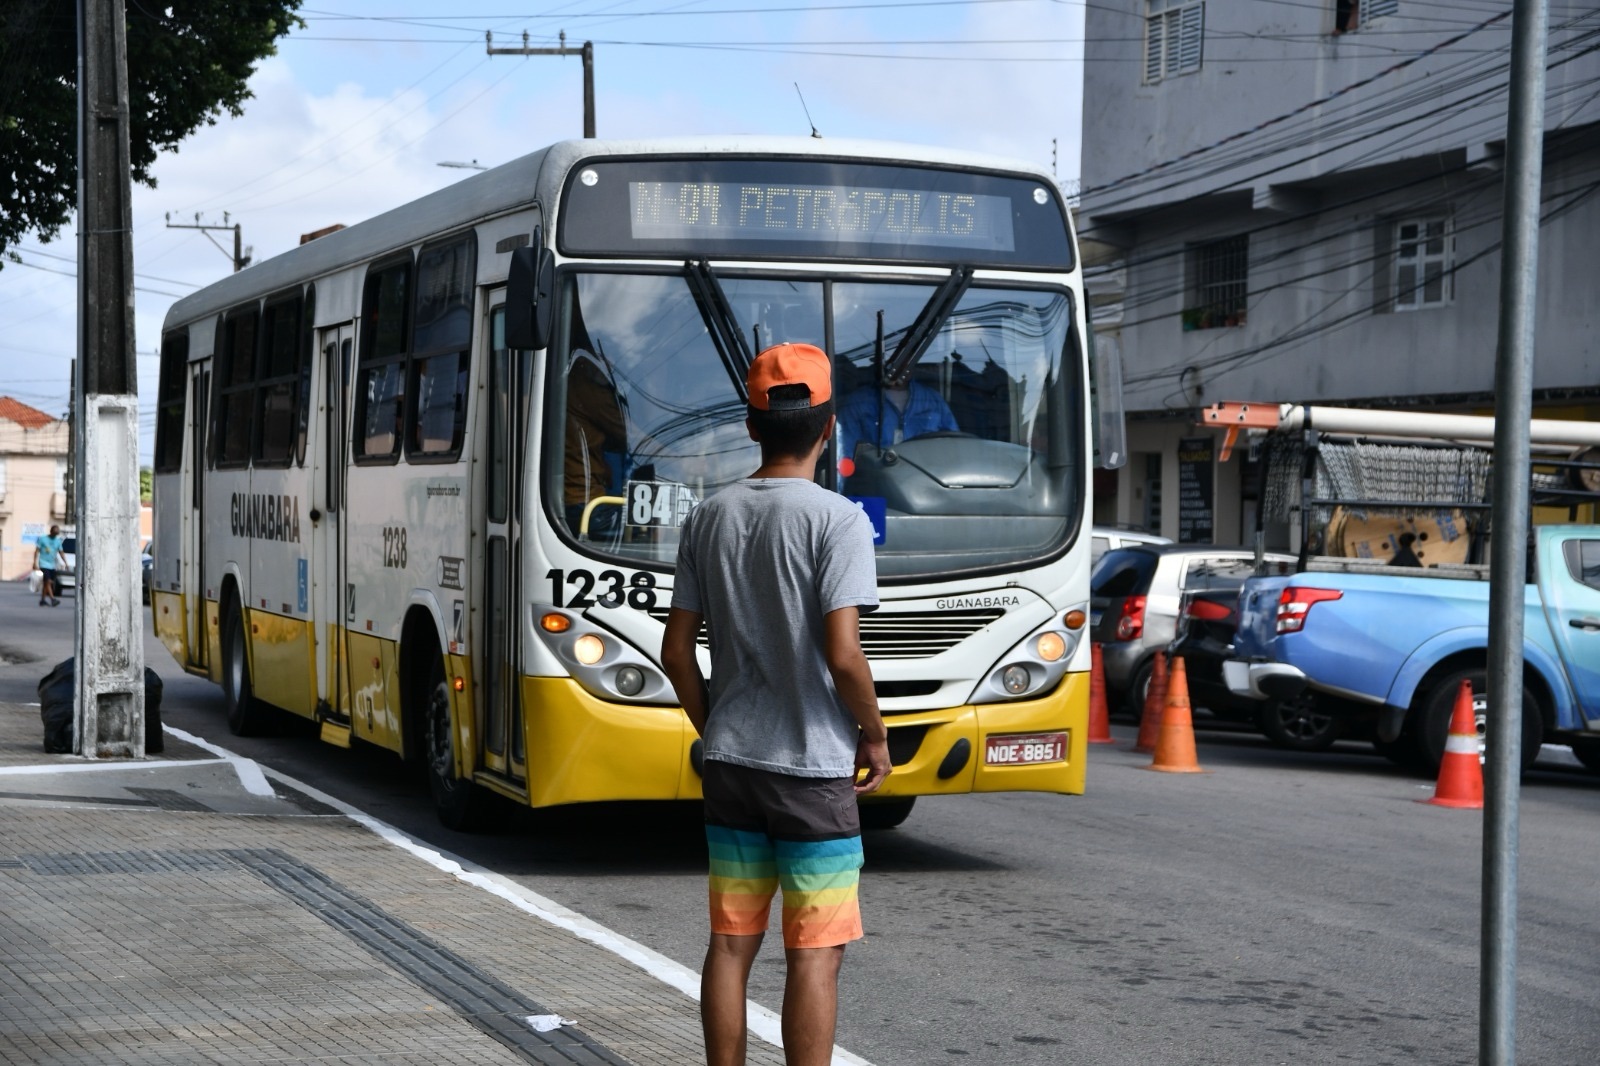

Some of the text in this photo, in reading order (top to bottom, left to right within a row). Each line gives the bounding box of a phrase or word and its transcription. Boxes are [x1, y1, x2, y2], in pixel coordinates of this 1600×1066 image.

[231, 492, 301, 544] GUANABARA
[632, 484, 672, 525] 84
[383, 526, 407, 569] 1238
[545, 568, 657, 611] 1238
[936, 596, 1020, 610] GUANABARA
